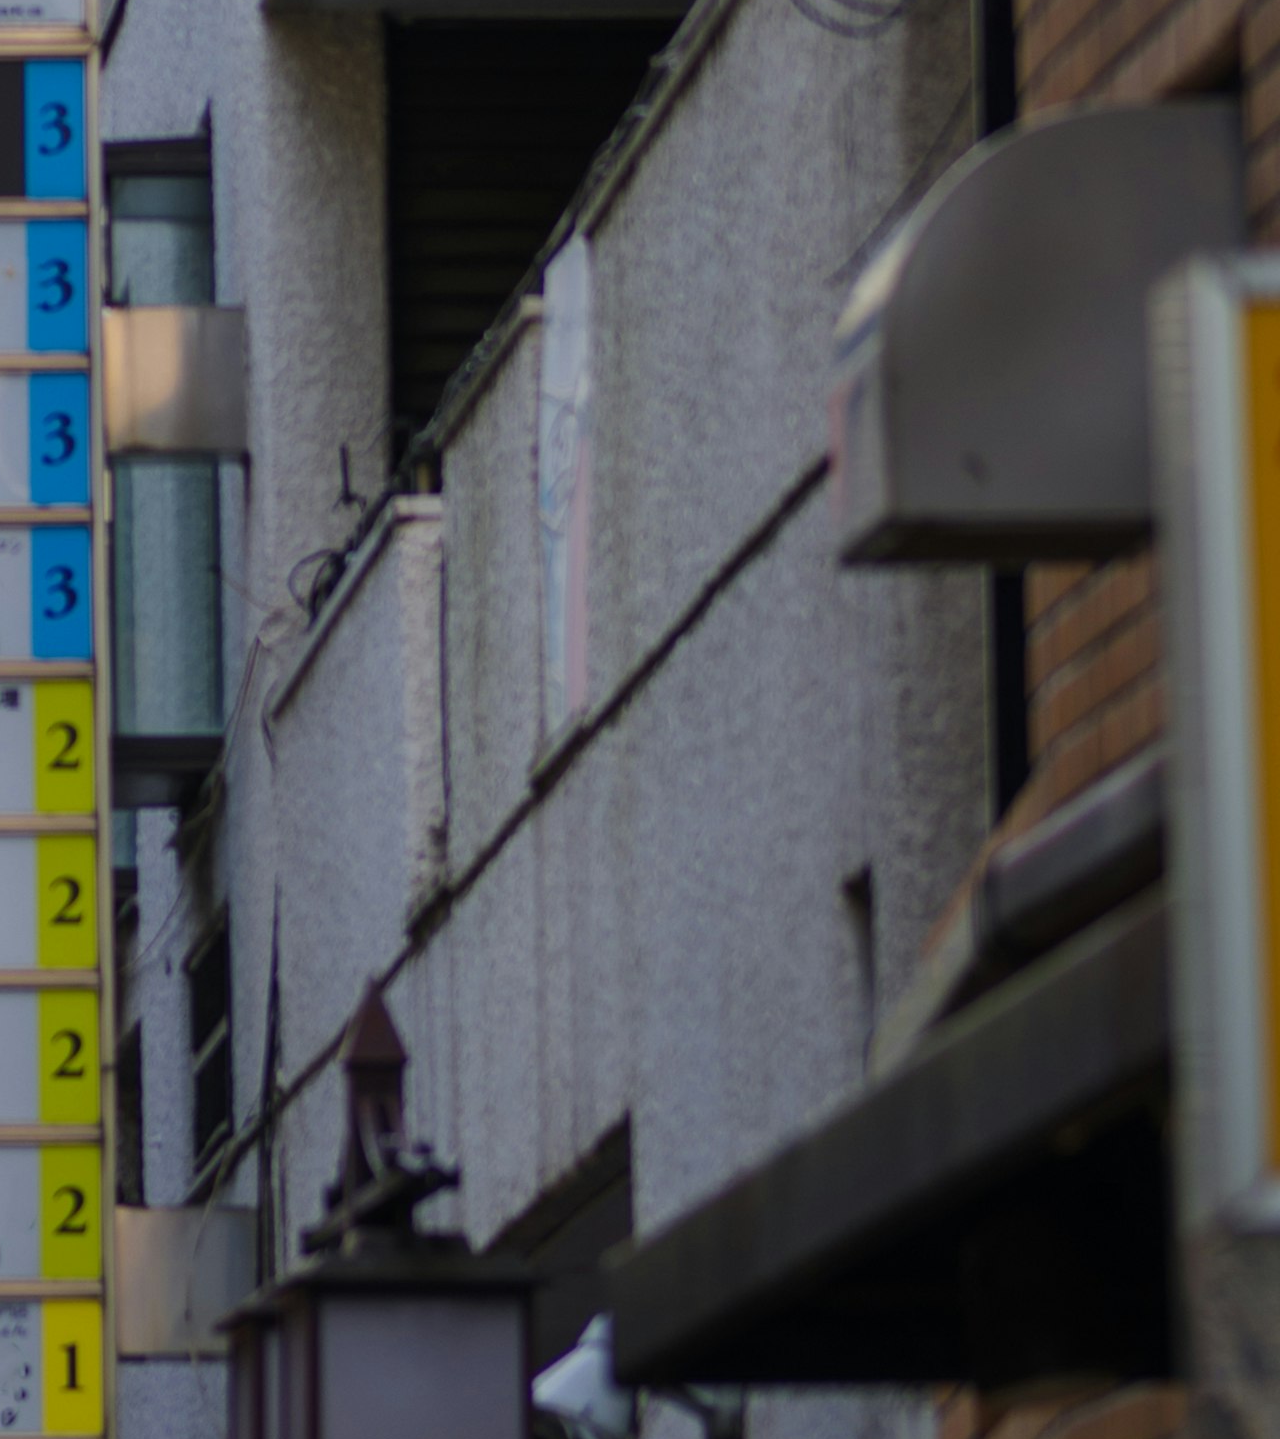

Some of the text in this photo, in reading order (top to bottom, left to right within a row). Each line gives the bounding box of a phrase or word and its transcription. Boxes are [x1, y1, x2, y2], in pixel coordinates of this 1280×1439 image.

[38, 102, 74, 155] 3
[37, 259, 76, 312] 3
[43, 412, 78, 465] 3
[44, 566, 79, 620] 3
[48, 722, 82, 771] 2
[50, 876, 84, 926] 2
[52, 1030, 87, 1080] 2
[54, 1185, 89, 1236] 2
[62, 1342, 83, 1392] 1
